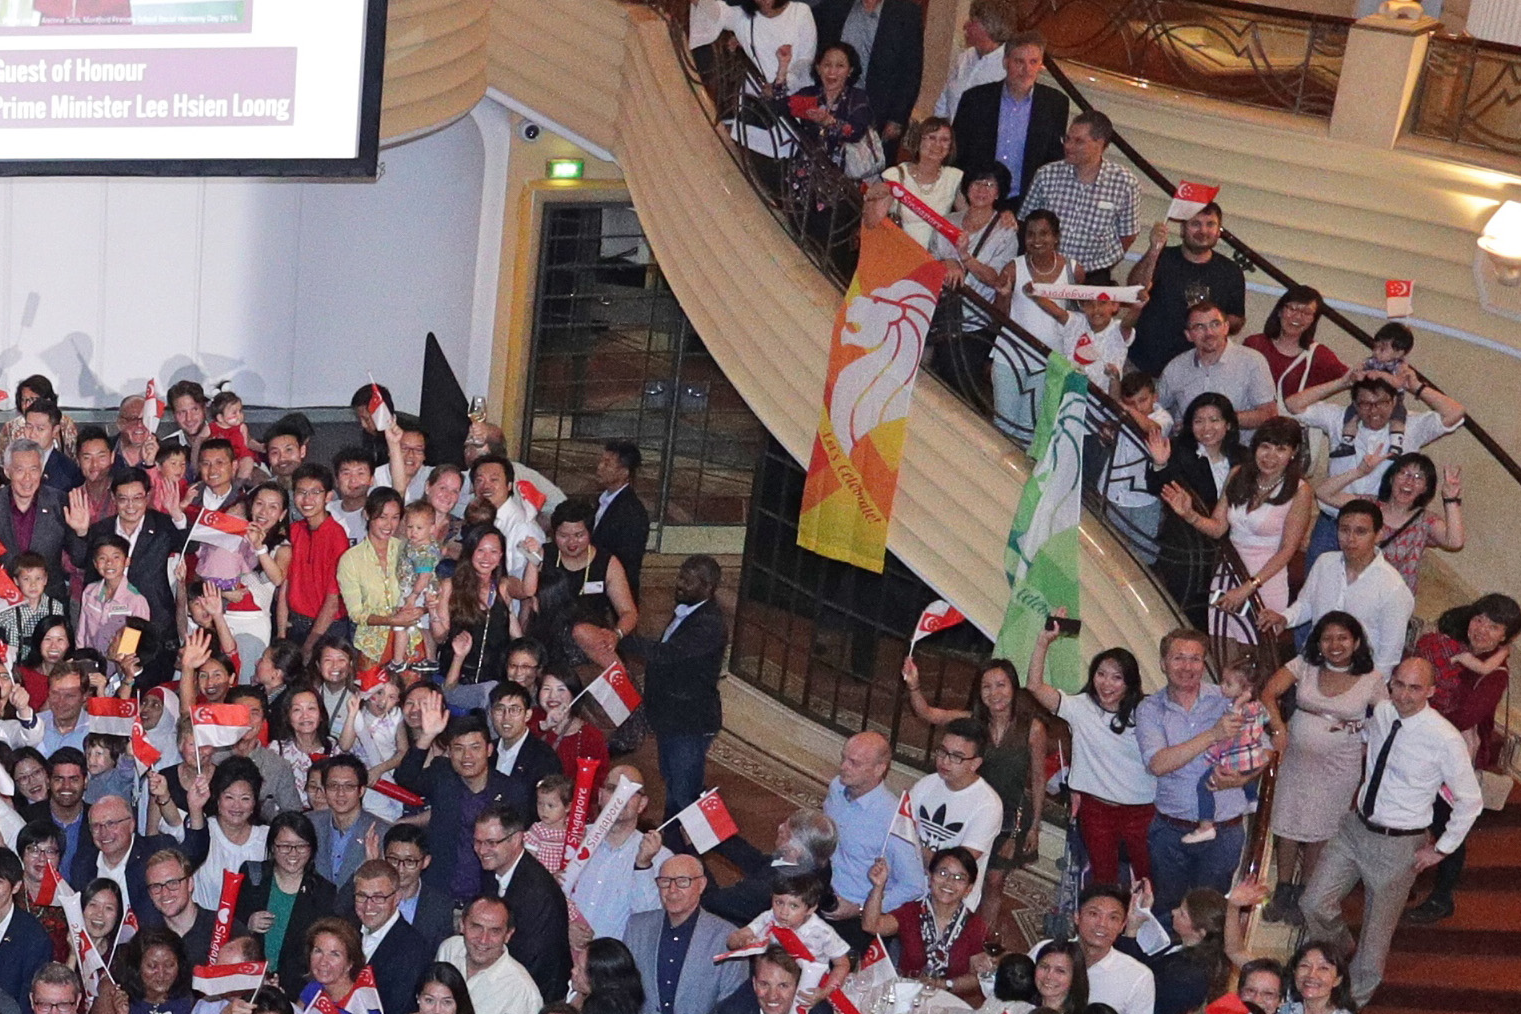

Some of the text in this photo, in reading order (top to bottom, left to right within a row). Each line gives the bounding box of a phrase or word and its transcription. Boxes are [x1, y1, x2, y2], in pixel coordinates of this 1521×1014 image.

[51, 58, 72, 82] of
[76, 58, 147, 82] Honour
[51, 94, 131, 119] Minister
[136, 94, 168, 118] Lee
[173, 93, 228, 118] Hsien
[233, 93, 290, 121] Loong
[822, 432, 841, 462] Let's
[567, 786, 588, 845] Singapore
[586, 797, 625, 848] Singapore
[208, 924, 226, 968] Singap
